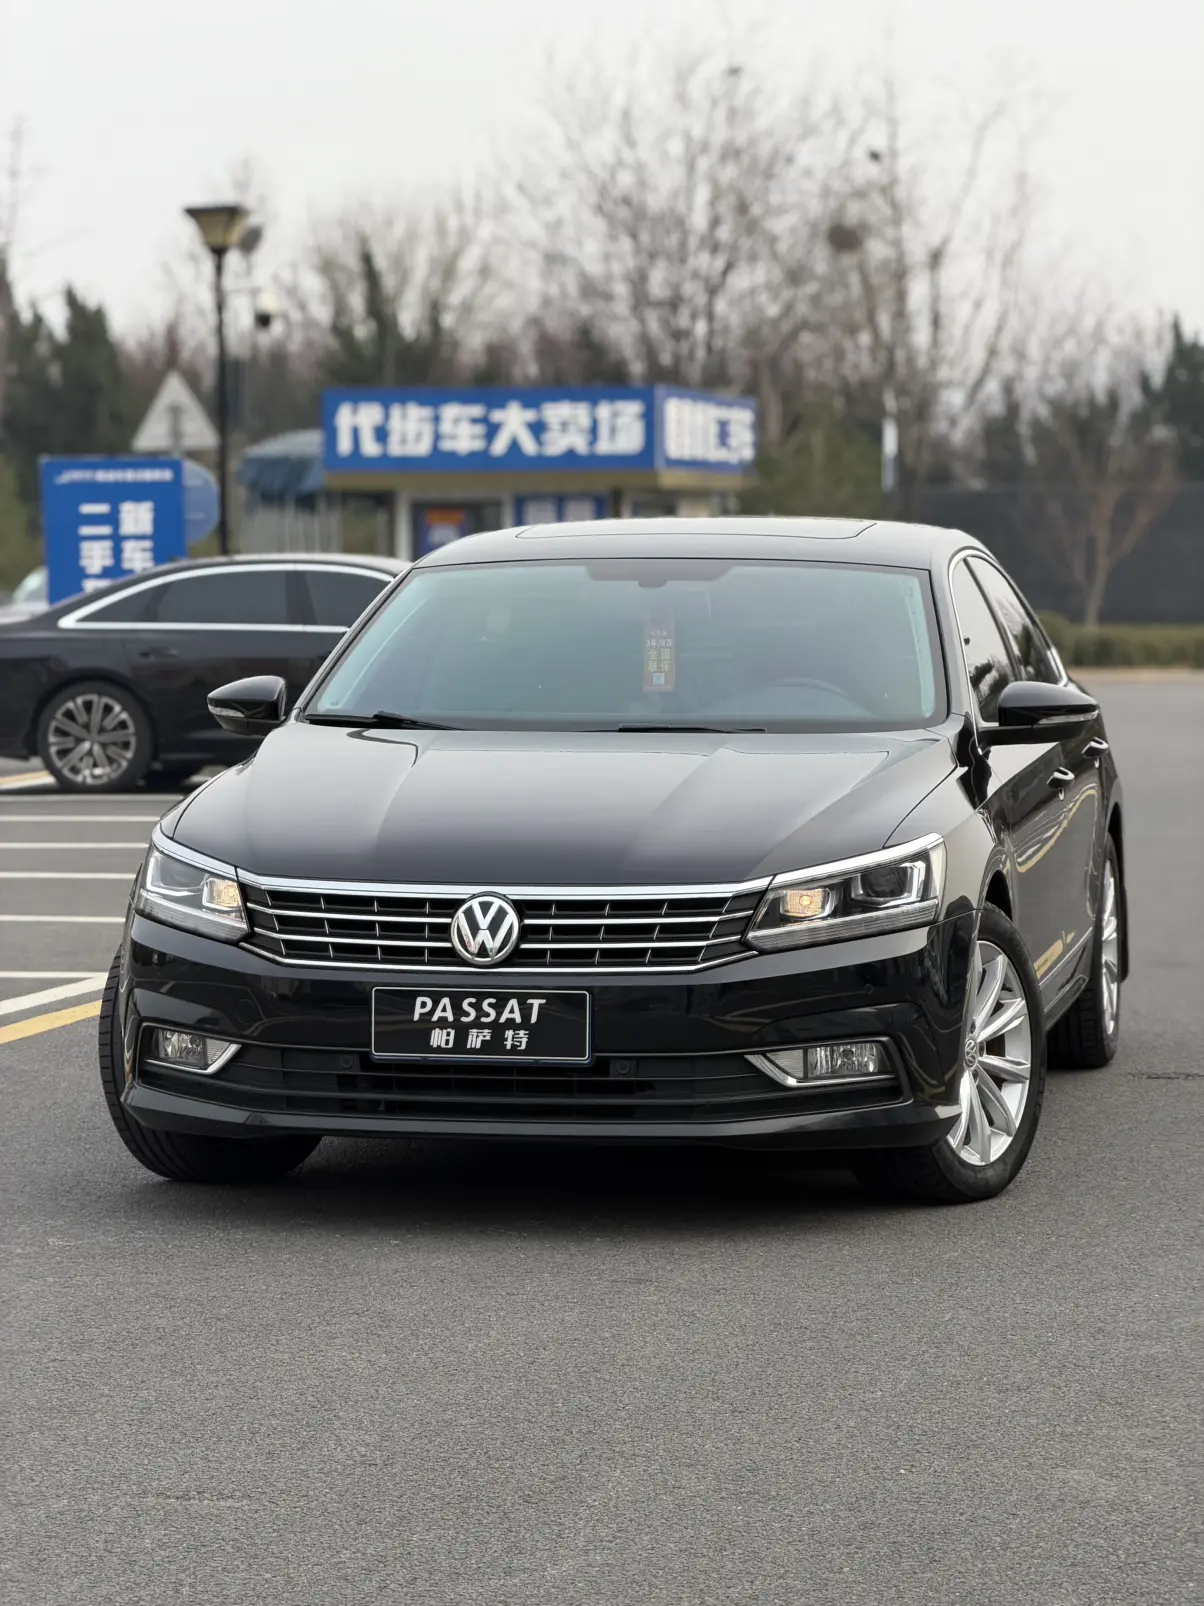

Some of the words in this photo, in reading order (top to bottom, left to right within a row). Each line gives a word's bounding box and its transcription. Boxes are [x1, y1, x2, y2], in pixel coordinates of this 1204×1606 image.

[334, 401, 646, 457] 代步车大卖场
[413, 996, 546, 1024] PASSAT
[429, 1028, 529, 1050] 帕萨特
